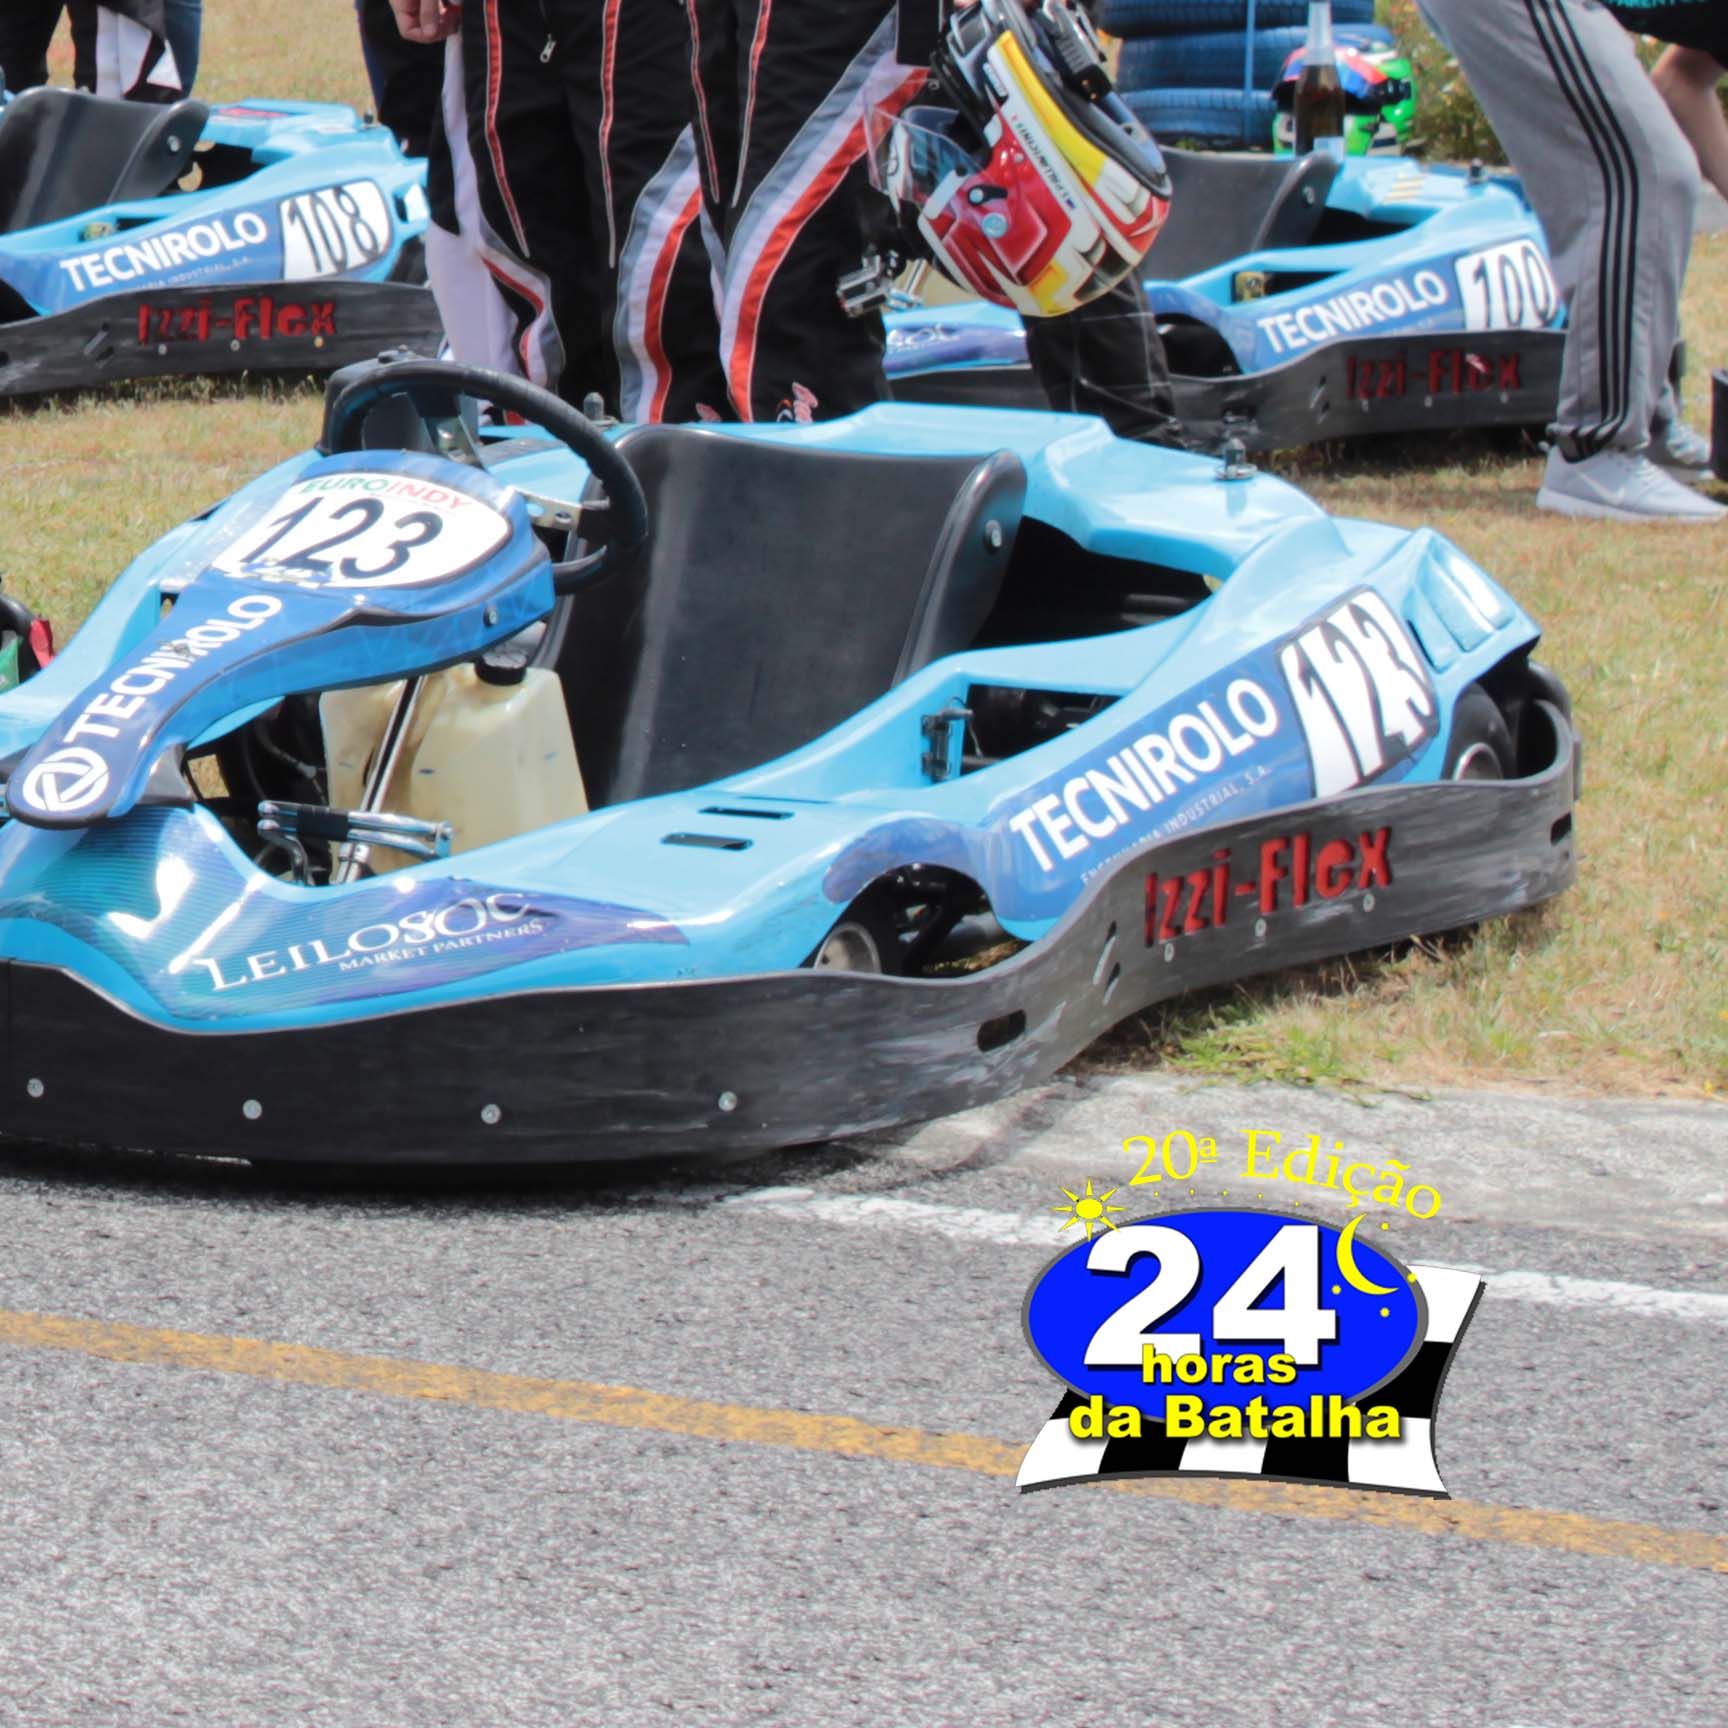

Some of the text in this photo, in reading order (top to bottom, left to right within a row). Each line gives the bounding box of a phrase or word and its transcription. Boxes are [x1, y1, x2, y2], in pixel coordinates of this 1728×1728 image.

[59, 211, 269, 292] TECNIROLO
[287, 186, 380, 274] 108
[1257, 270, 1449, 354] TECNIROLO
[1473, 243, 1560, 330] 100
[299, 476, 473, 511] EUROINDY
[240, 496, 444, 580] 123
[63, 594, 284, 744] TECNIROLO
[1009, 678, 1281, 872] TECNIROLO
[1145, 825, 1393, 948] Izzi-Flex
[192, 892, 532, 992] LEILOSOC
[339, 919, 545, 972] MARKET PARTNERS
